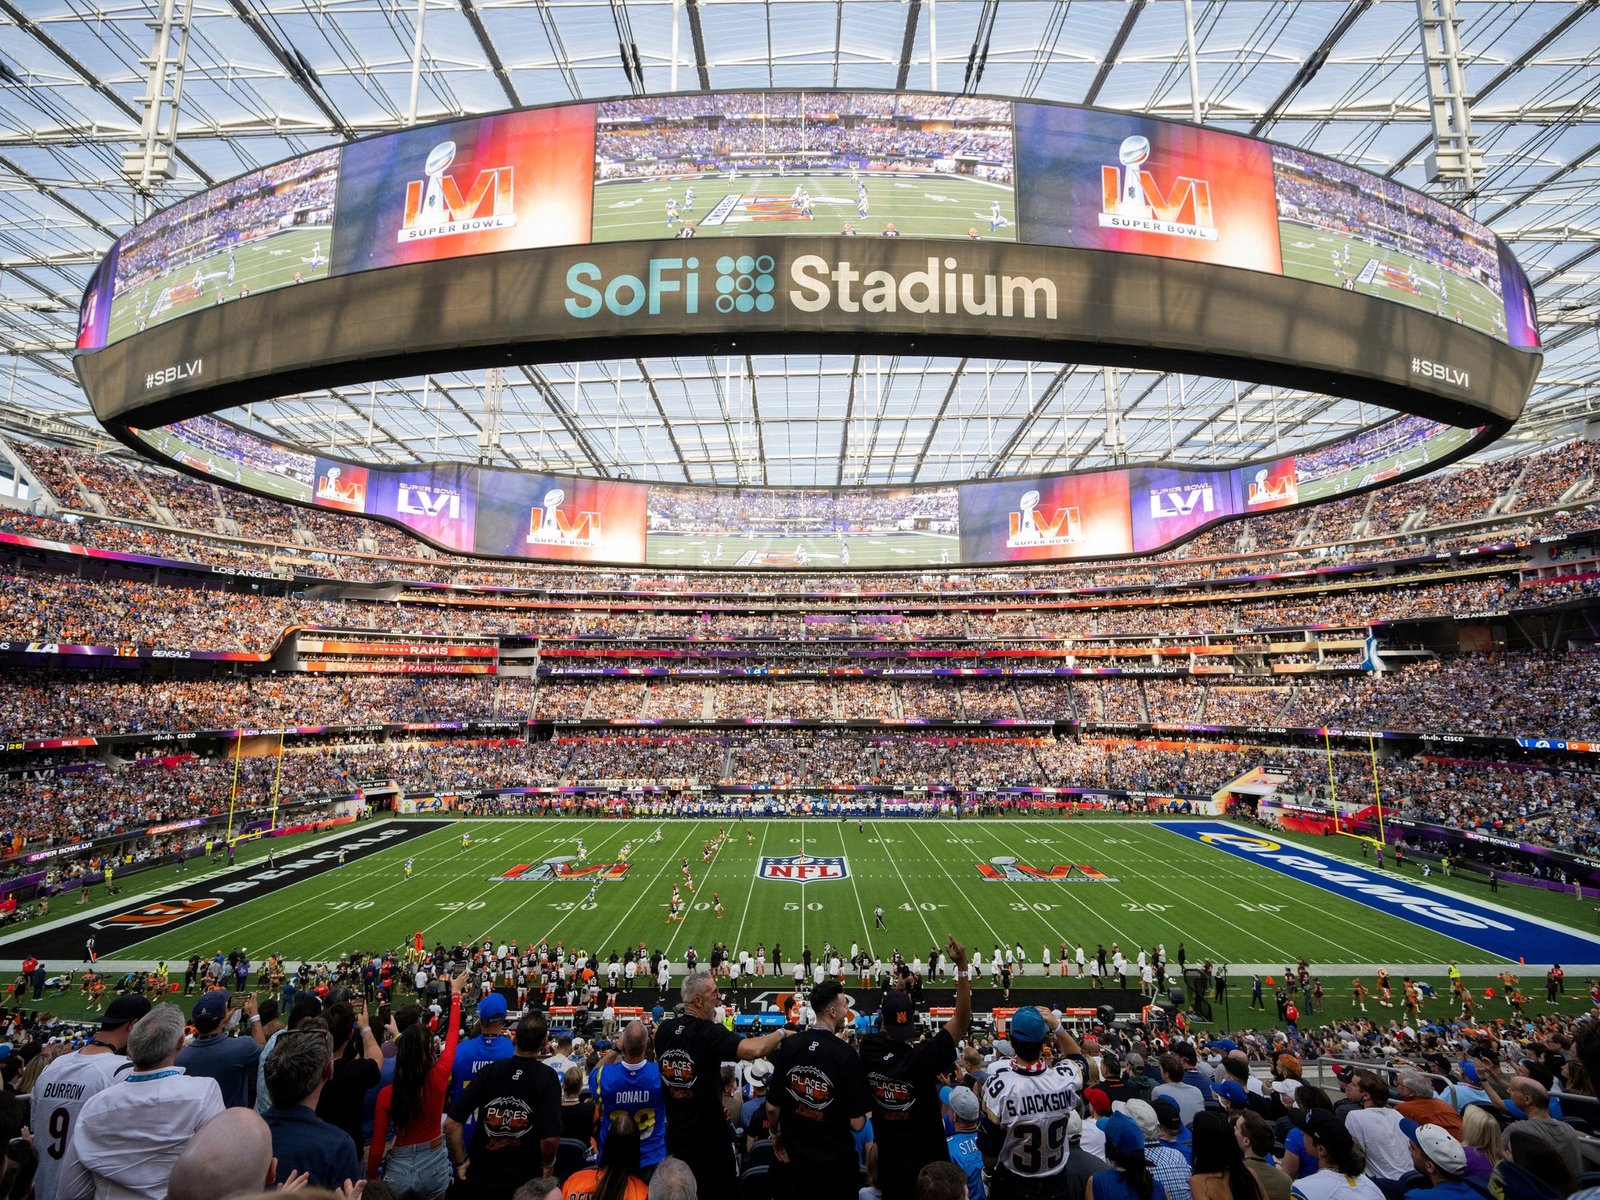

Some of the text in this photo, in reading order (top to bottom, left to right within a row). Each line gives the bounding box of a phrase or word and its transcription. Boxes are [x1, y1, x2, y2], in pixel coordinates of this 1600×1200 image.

[409, 219, 504, 239] SUPER BOWL
[1111, 217, 1207, 238] SUPER BOWL
[564, 254, 1059, 320] SoFi Stadium
[145, 359, 204, 389] #SBLVI
[1411, 357, 1469, 388] #SBLVI
[400, 483, 460, 497] SUPER BOWL
[1150, 482, 1212, 496] SUPER BOWL
[397, 489, 460, 519] LVI
[1150, 488, 1214, 519] LVI
[534, 536, 596, 547] SUPER BOWL
[211, 565, 295, 582] LOS ANGELES
[1470, 610, 1510, 619] ANGELES
[151, 650, 191, 659] BENGALS
[409, 646, 449, 656] RAMS
[336, 663, 464, 673] WHOSE HOUSE? RAMS HOUSE!
[177, 732, 197, 740] CISCO
[243, 727, 298, 737] LOS ANGELES
[1343, 730, 1384, 738] ANGELES
[1443, 735, 1465, 743] CISCO
[151, 819, 201, 835] LOS ANGELES
[1466, 832, 1521, 849] SUPER BOWL LVI
[30, 841, 94, 862] SUPER BOWL LVI
[209, 829, 409, 894] BENGALS
[768, 865, 839, 879] NFL
[1261, 853, 1516, 932] RAMS
[332, 901, 375, 910] 10
[442, 901, 487, 911] 20
[554, 901, 598, 911] 30
[783, 901, 824, 911] 50
[898, 901, 937, 911] 40
[1008, 901, 1055, 912] 30
[1120, 901, 1167, 912] 20
[1235, 901, 1280, 912] 10
[662, 1059, 692, 1072] PLACES
[791, 1073, 828, 1093] PLACES
[870, 1080, 908, 1094] PLACES
[44, 1082, 86, 1101] BURROW
[616, 1090, 650, 1105] DONALD
[1020, 1089, 1072, 1117] JACKSON
[487, 1107, 528, 1121] PLACES
[47, 1107, 70, 1161] 9
[1012, 1115, 1070, 1173] 39
